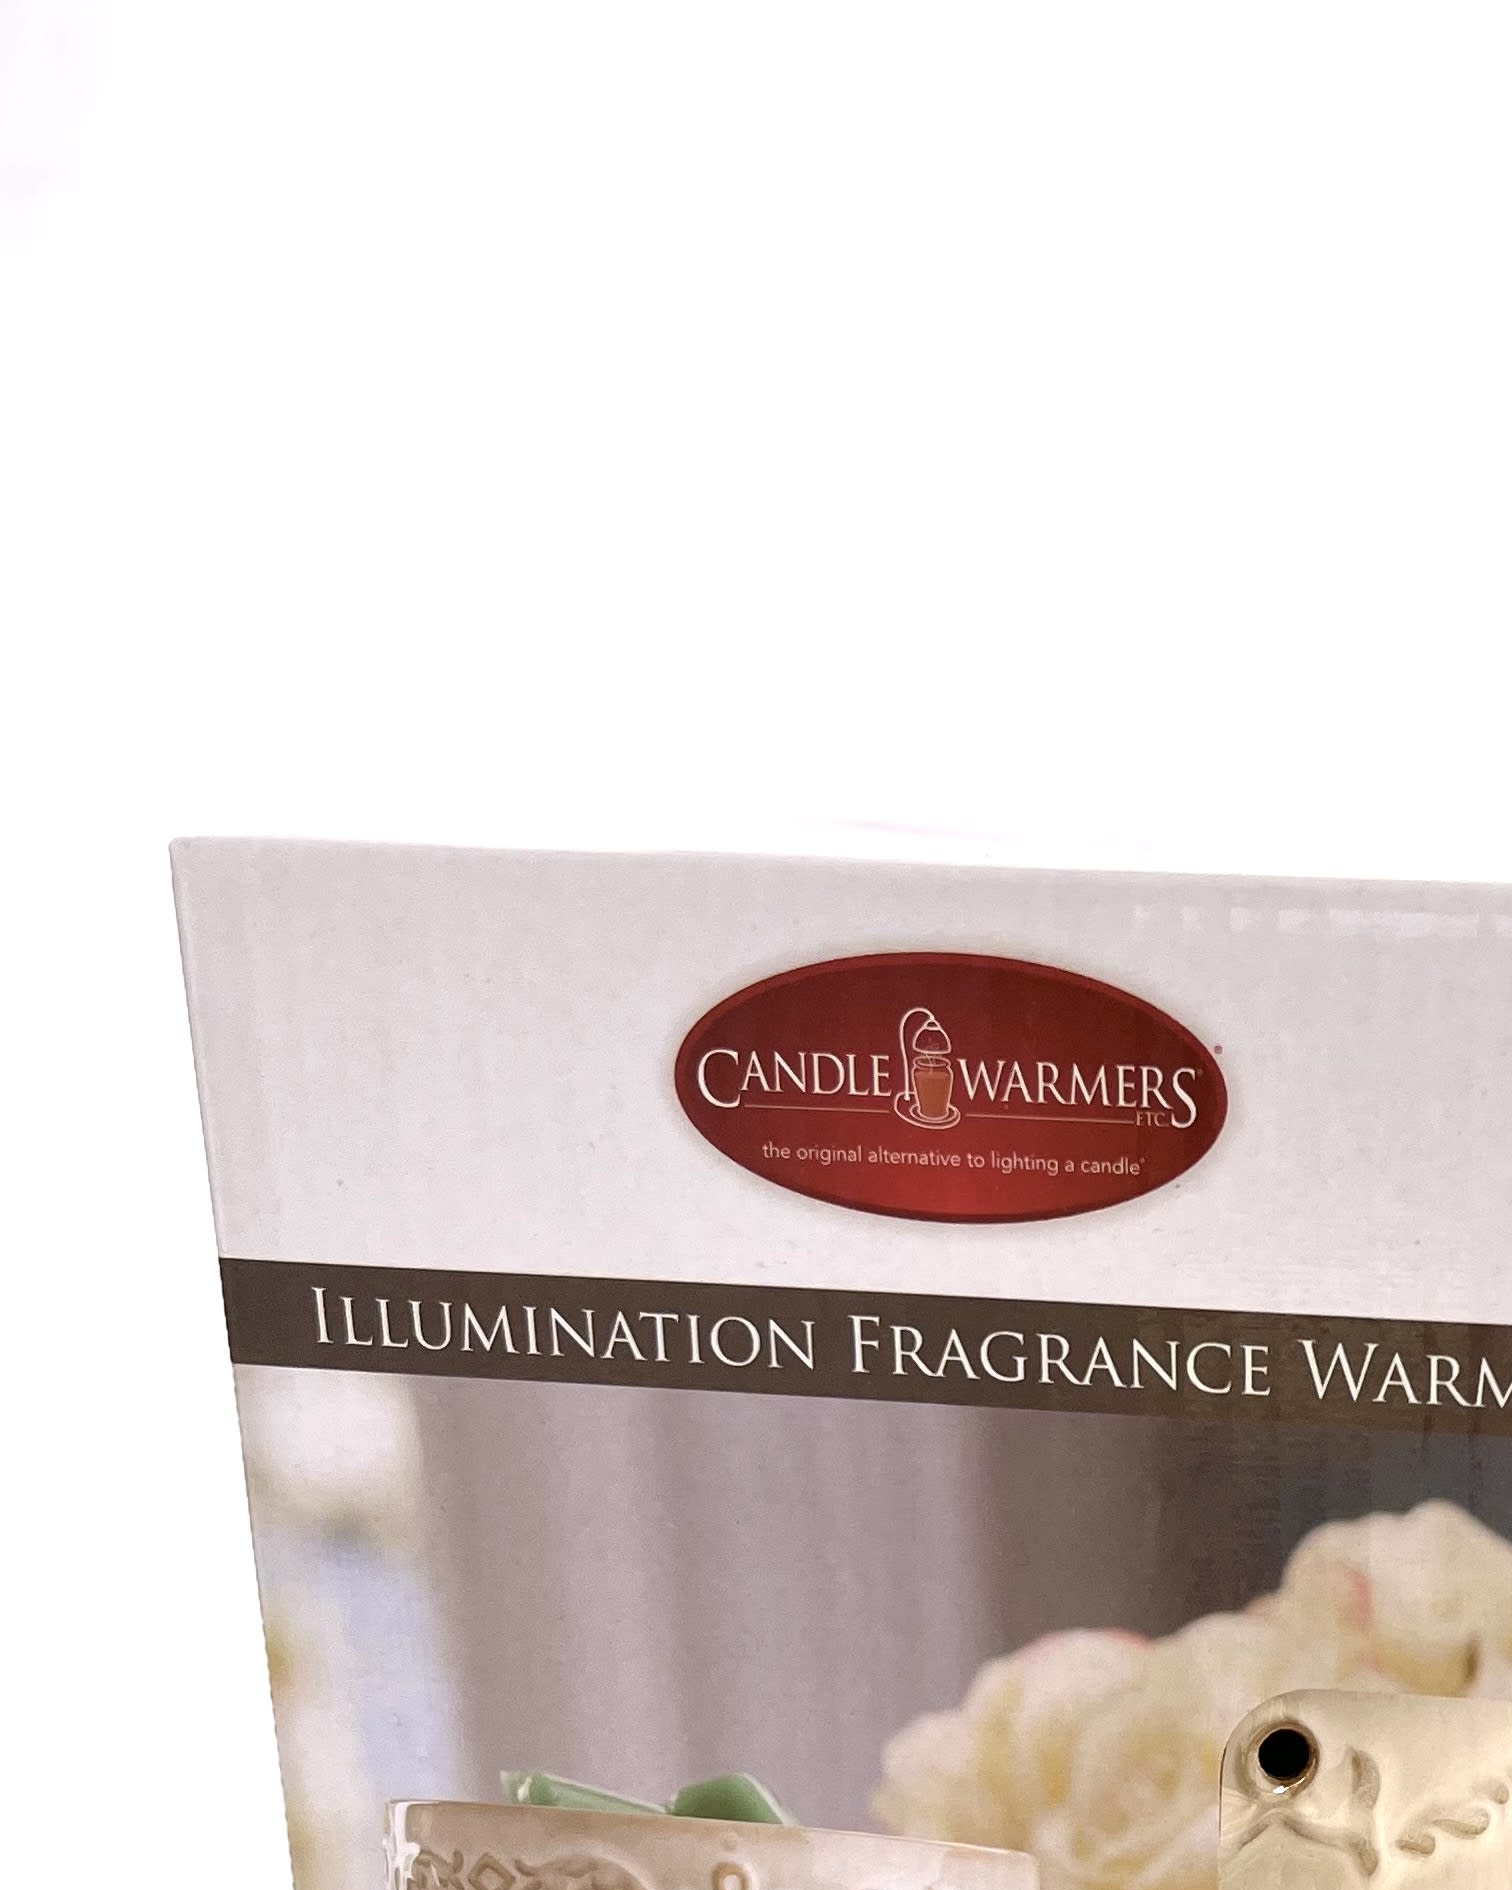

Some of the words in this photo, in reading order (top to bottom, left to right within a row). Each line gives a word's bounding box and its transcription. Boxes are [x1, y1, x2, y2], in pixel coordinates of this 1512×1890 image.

[697, 1049, 892, 1108] CANDLE
[958, 1058, 1198, 1129] WARMERS
[762, 1143, 791, 1160] the
[796, 1145, 862, 1167] original
[868, 1146, 961, 1168] alternative
[967, 1152, 985, 1168] to
[991, 1151, 1059, 1175] lighting
[1064, 1160, 1075, 1172] a
[311, 1286, 816, 1371] ILLUMINATION
[849, 1314, 1272, 1397] FRAGRANCE
